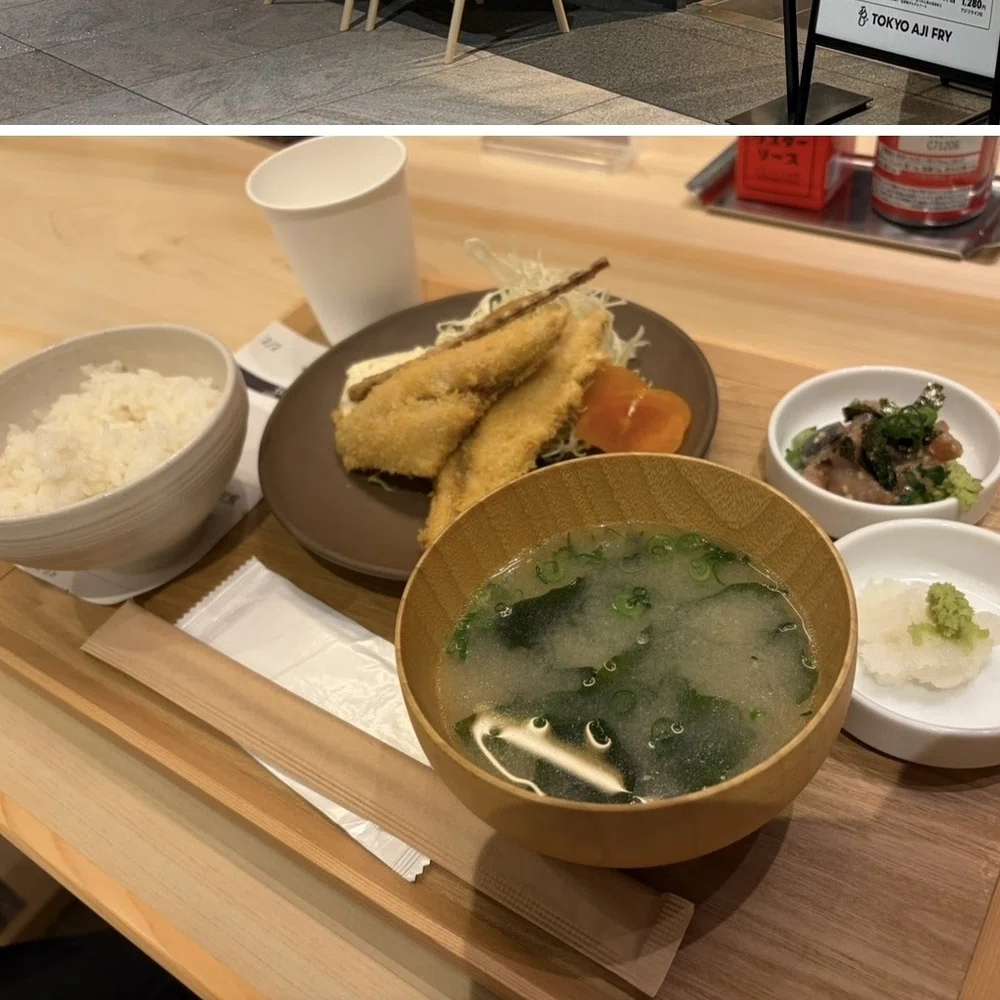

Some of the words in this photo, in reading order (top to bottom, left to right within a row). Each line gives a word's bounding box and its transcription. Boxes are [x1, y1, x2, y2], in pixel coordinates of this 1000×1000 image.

[871, 13, 910, 33] TOKYO
[911, 22, 929, 38] AJI
[931, 27, 953, 43] FRY
